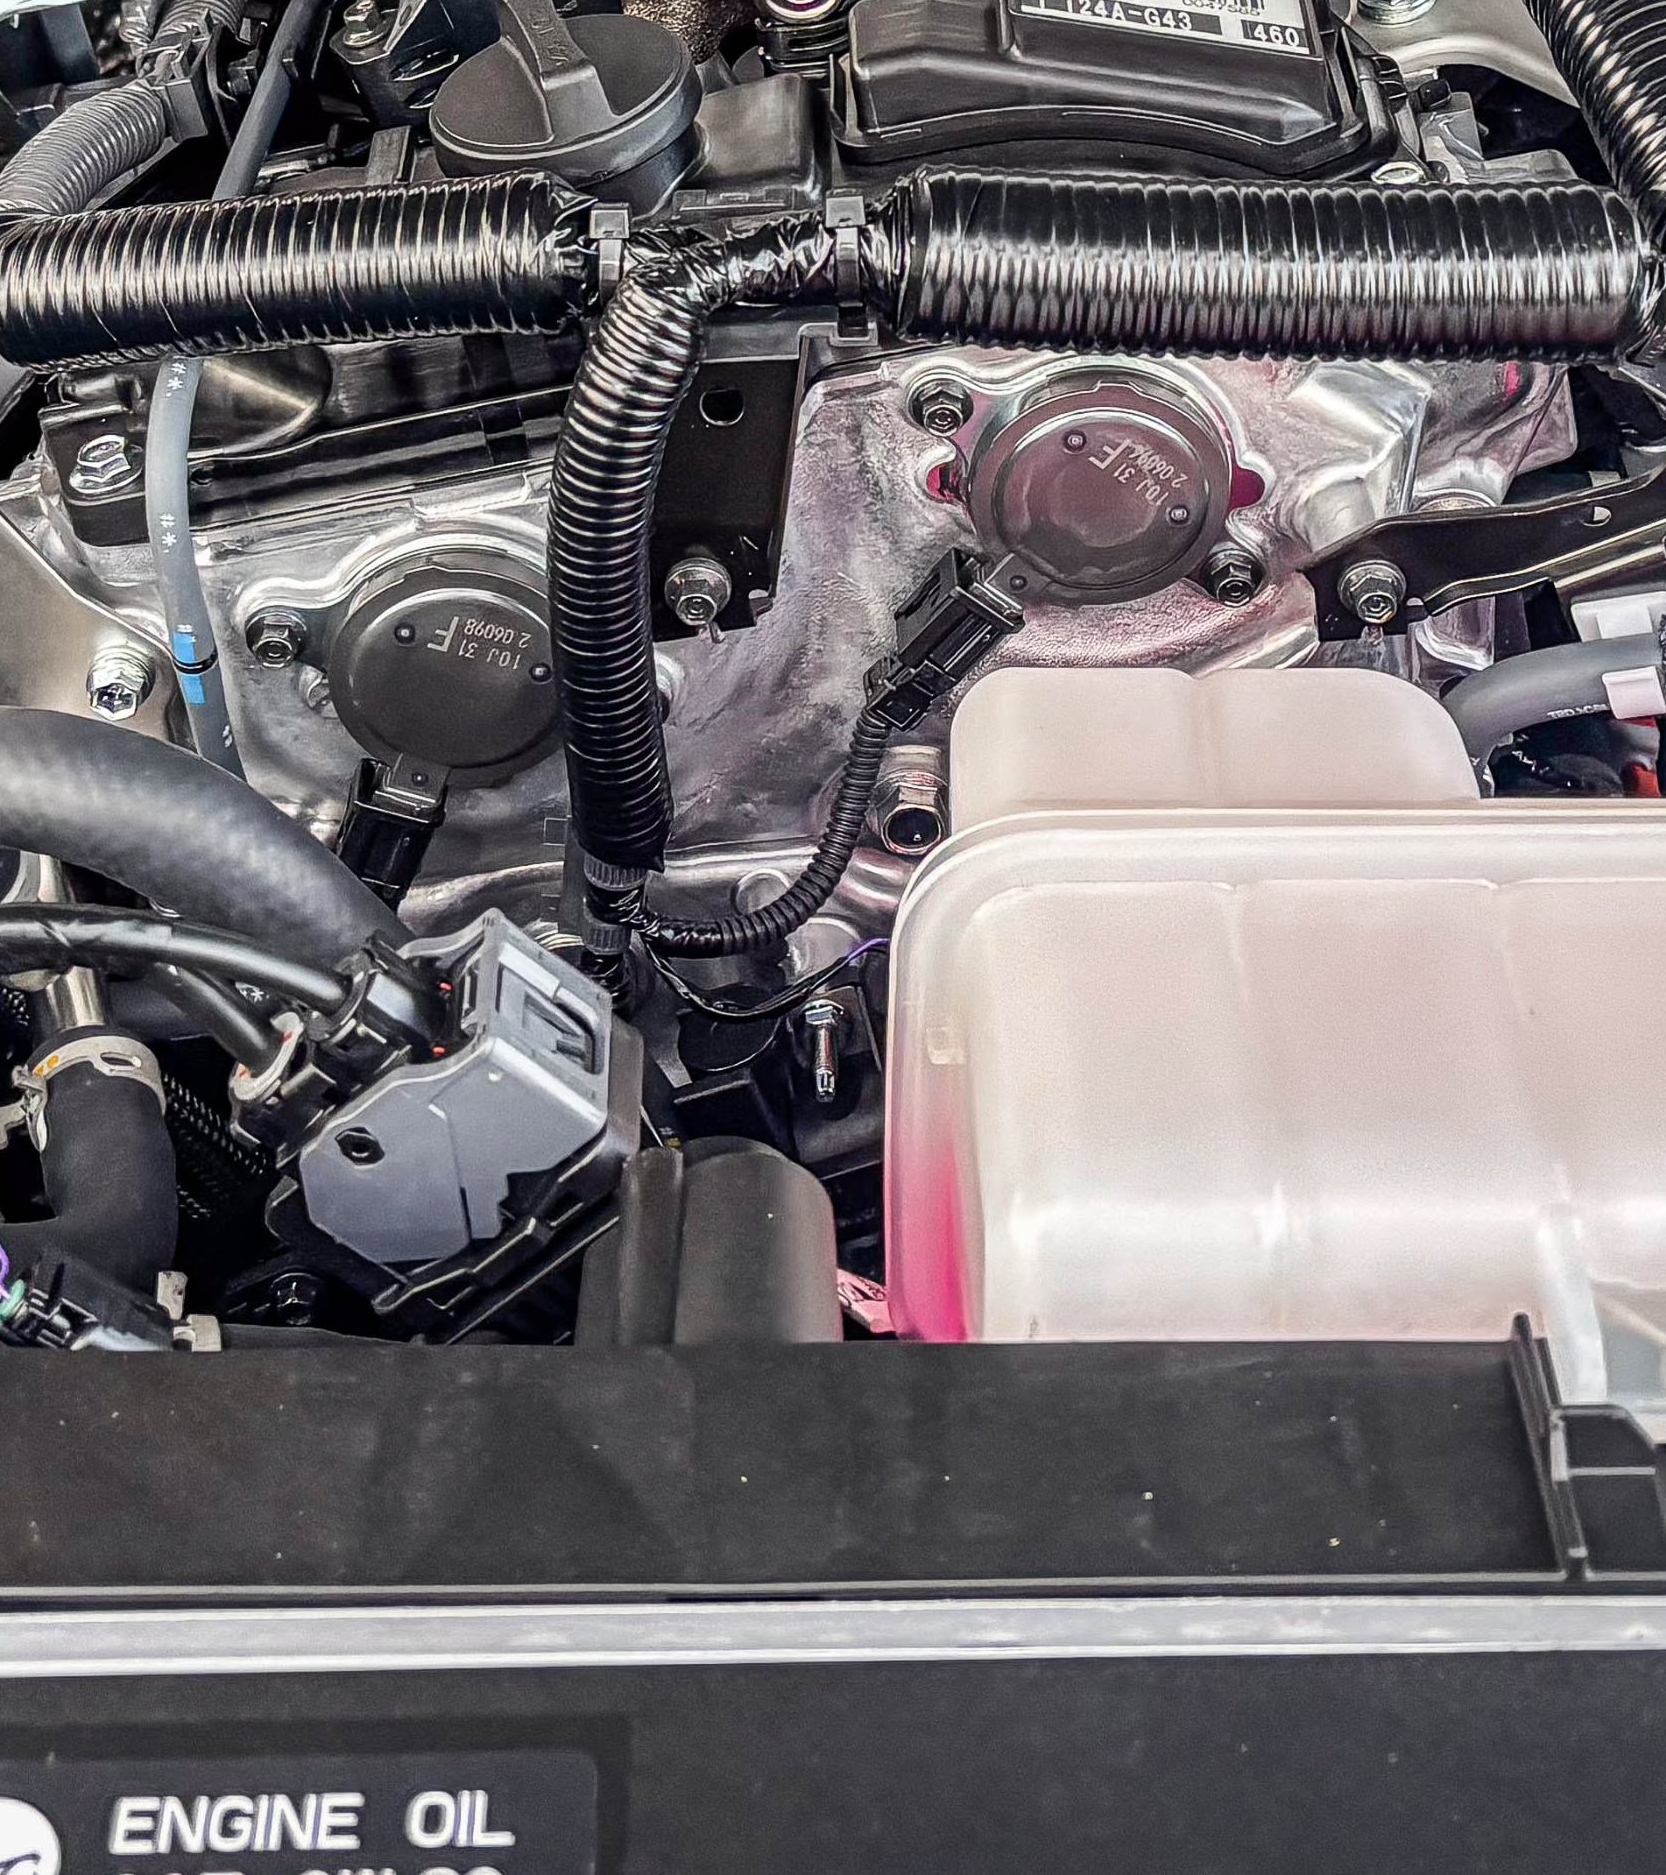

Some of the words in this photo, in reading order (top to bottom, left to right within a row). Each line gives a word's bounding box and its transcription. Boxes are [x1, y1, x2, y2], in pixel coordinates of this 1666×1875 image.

[1253, 23, 1301, 48] 460
[1113, 463, 1136, 484] 31
[426, 615, 460, 653] F
[463, 618, 514, 645] 06098
[518, 631, 532, 649] 2
[457, 638, 479, 659] 31
[485, 647, 522, 670] 10J
[107, 1792, 366, 1855] ENGINE
[405, 1789, 517, 1848] OIL
